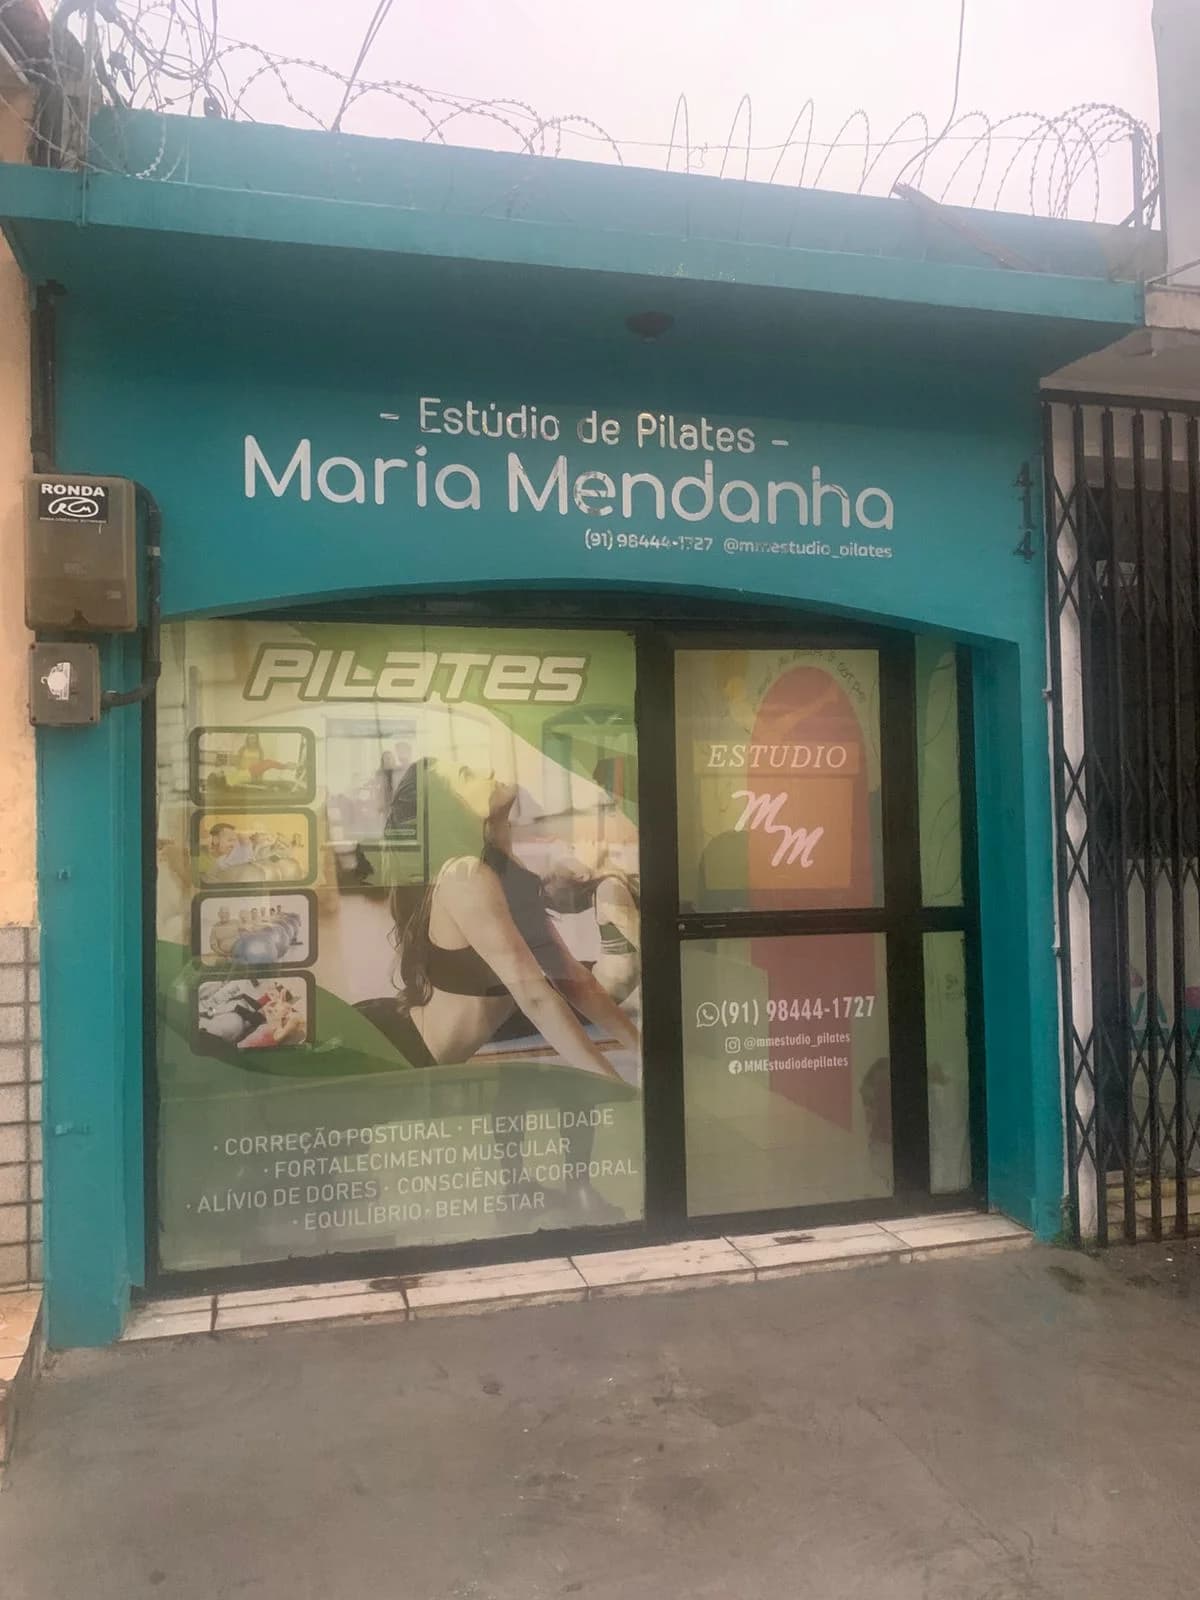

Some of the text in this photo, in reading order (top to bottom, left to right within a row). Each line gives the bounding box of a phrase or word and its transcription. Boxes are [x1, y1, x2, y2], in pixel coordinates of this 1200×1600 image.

[419, 396, 562, 442] Estúdio
[576, 410, 621, 446] de
[637, 412, 756, 453] Pilates
[41, 483, 105, 497] RONDA
[244, 434, 894, 531] Maria Mendanha
[585, 528, 613, 550] (91)
[708, 744, 847, 769] ESTUDIO
[721, 995, 875, 1027] (91) 98444-1727
[743, 1032, 850, 1050] @mmestudio_pilates
[744, 1056, 848, 1073] MMEstudiodepilates
[225, 1108, 615, 1155] CORREÇÃO POSTURAL FLEXIBILIDADE
[275, 1137, 571, 1178] FORTALECIMENTO MUSCULAR
[197, 1159, 639, 1213] ALÍVIO DE DORES CONSCIÊNCIA CORPORAL
[304, 1192, 545, 1231] EQUILÍBRIO BEM ESTAR
